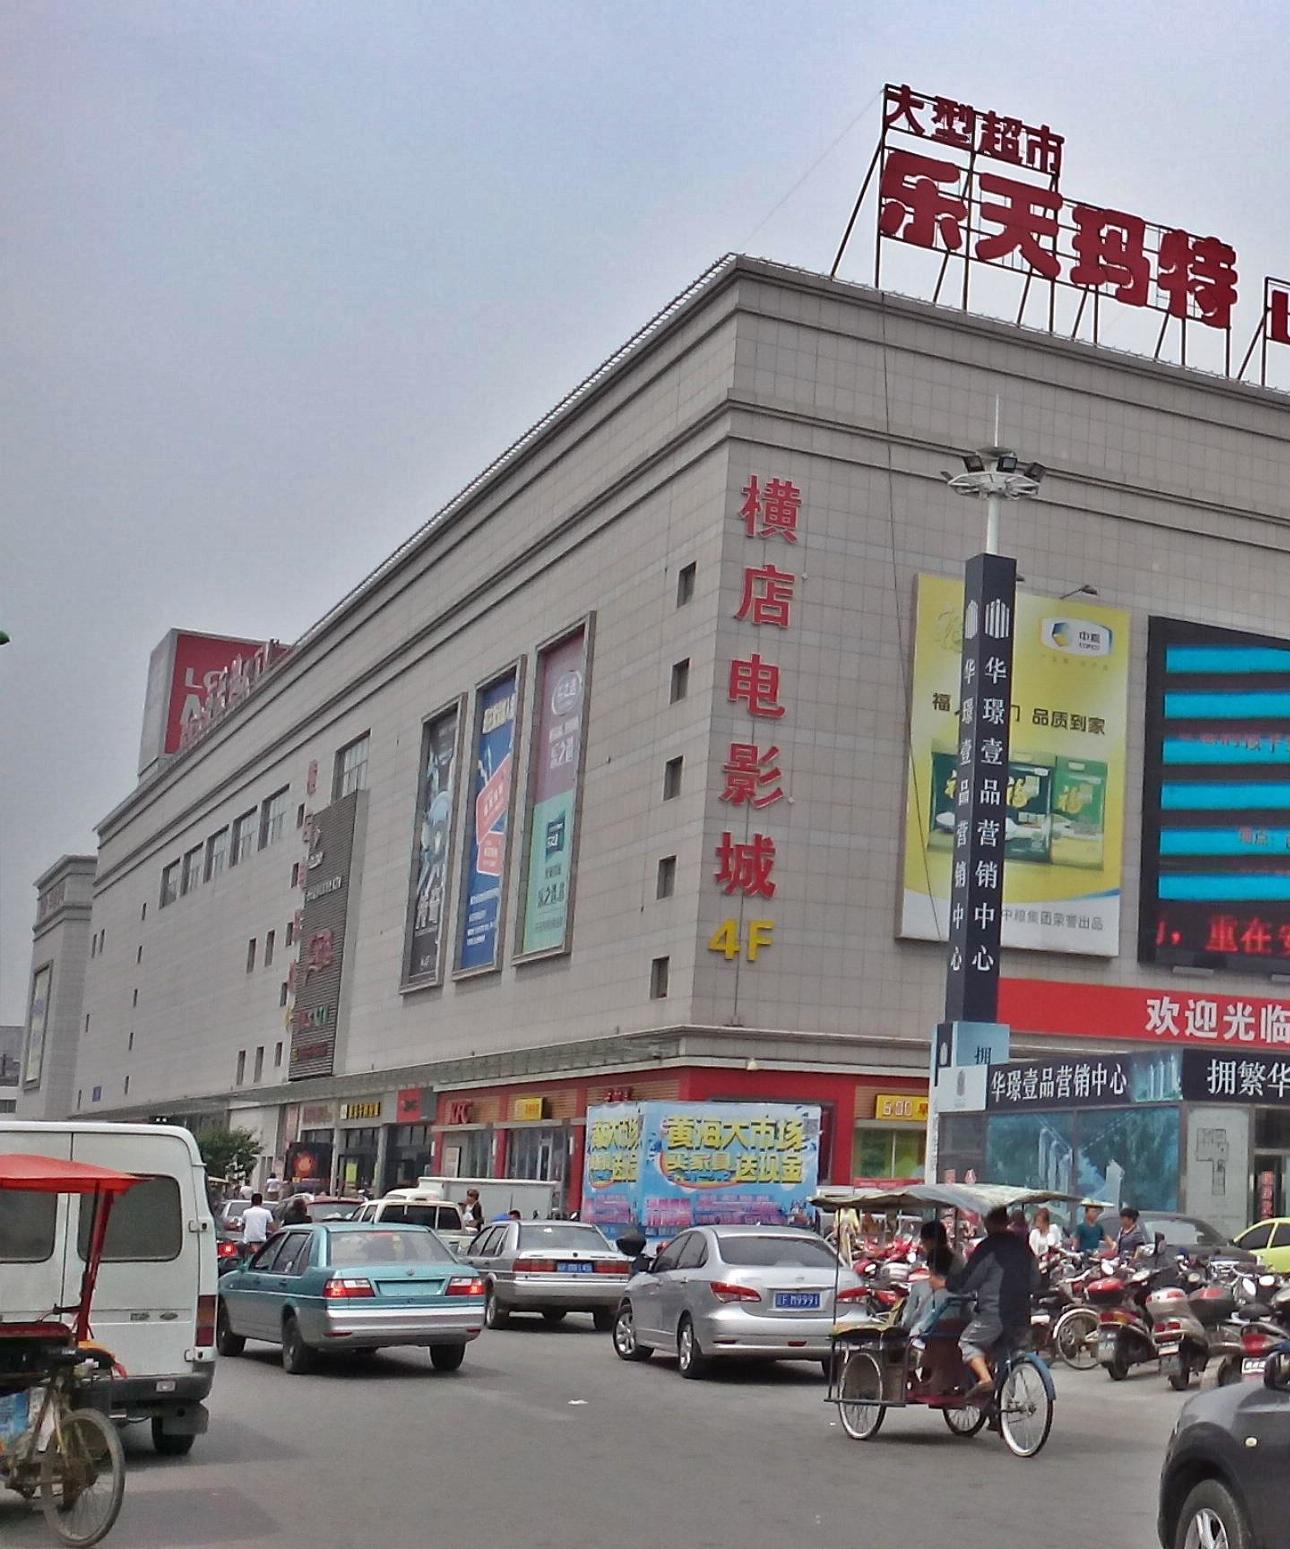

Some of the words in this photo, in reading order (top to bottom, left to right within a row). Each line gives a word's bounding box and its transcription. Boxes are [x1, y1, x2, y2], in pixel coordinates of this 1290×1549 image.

[885, 84, 1065, 174] 大型超市
[880, 150, 1240, 330] 乐天玛特
[713, 474, 801, 898] 横店电影城
[1032, 708, 1105, 735] 品质到家
[708, 918, 775, 961] 4F
[991, 1062, 1127, 1103] 华璟壹品营销中心
[667, 1118, 808, 1152] 黄海大市场
